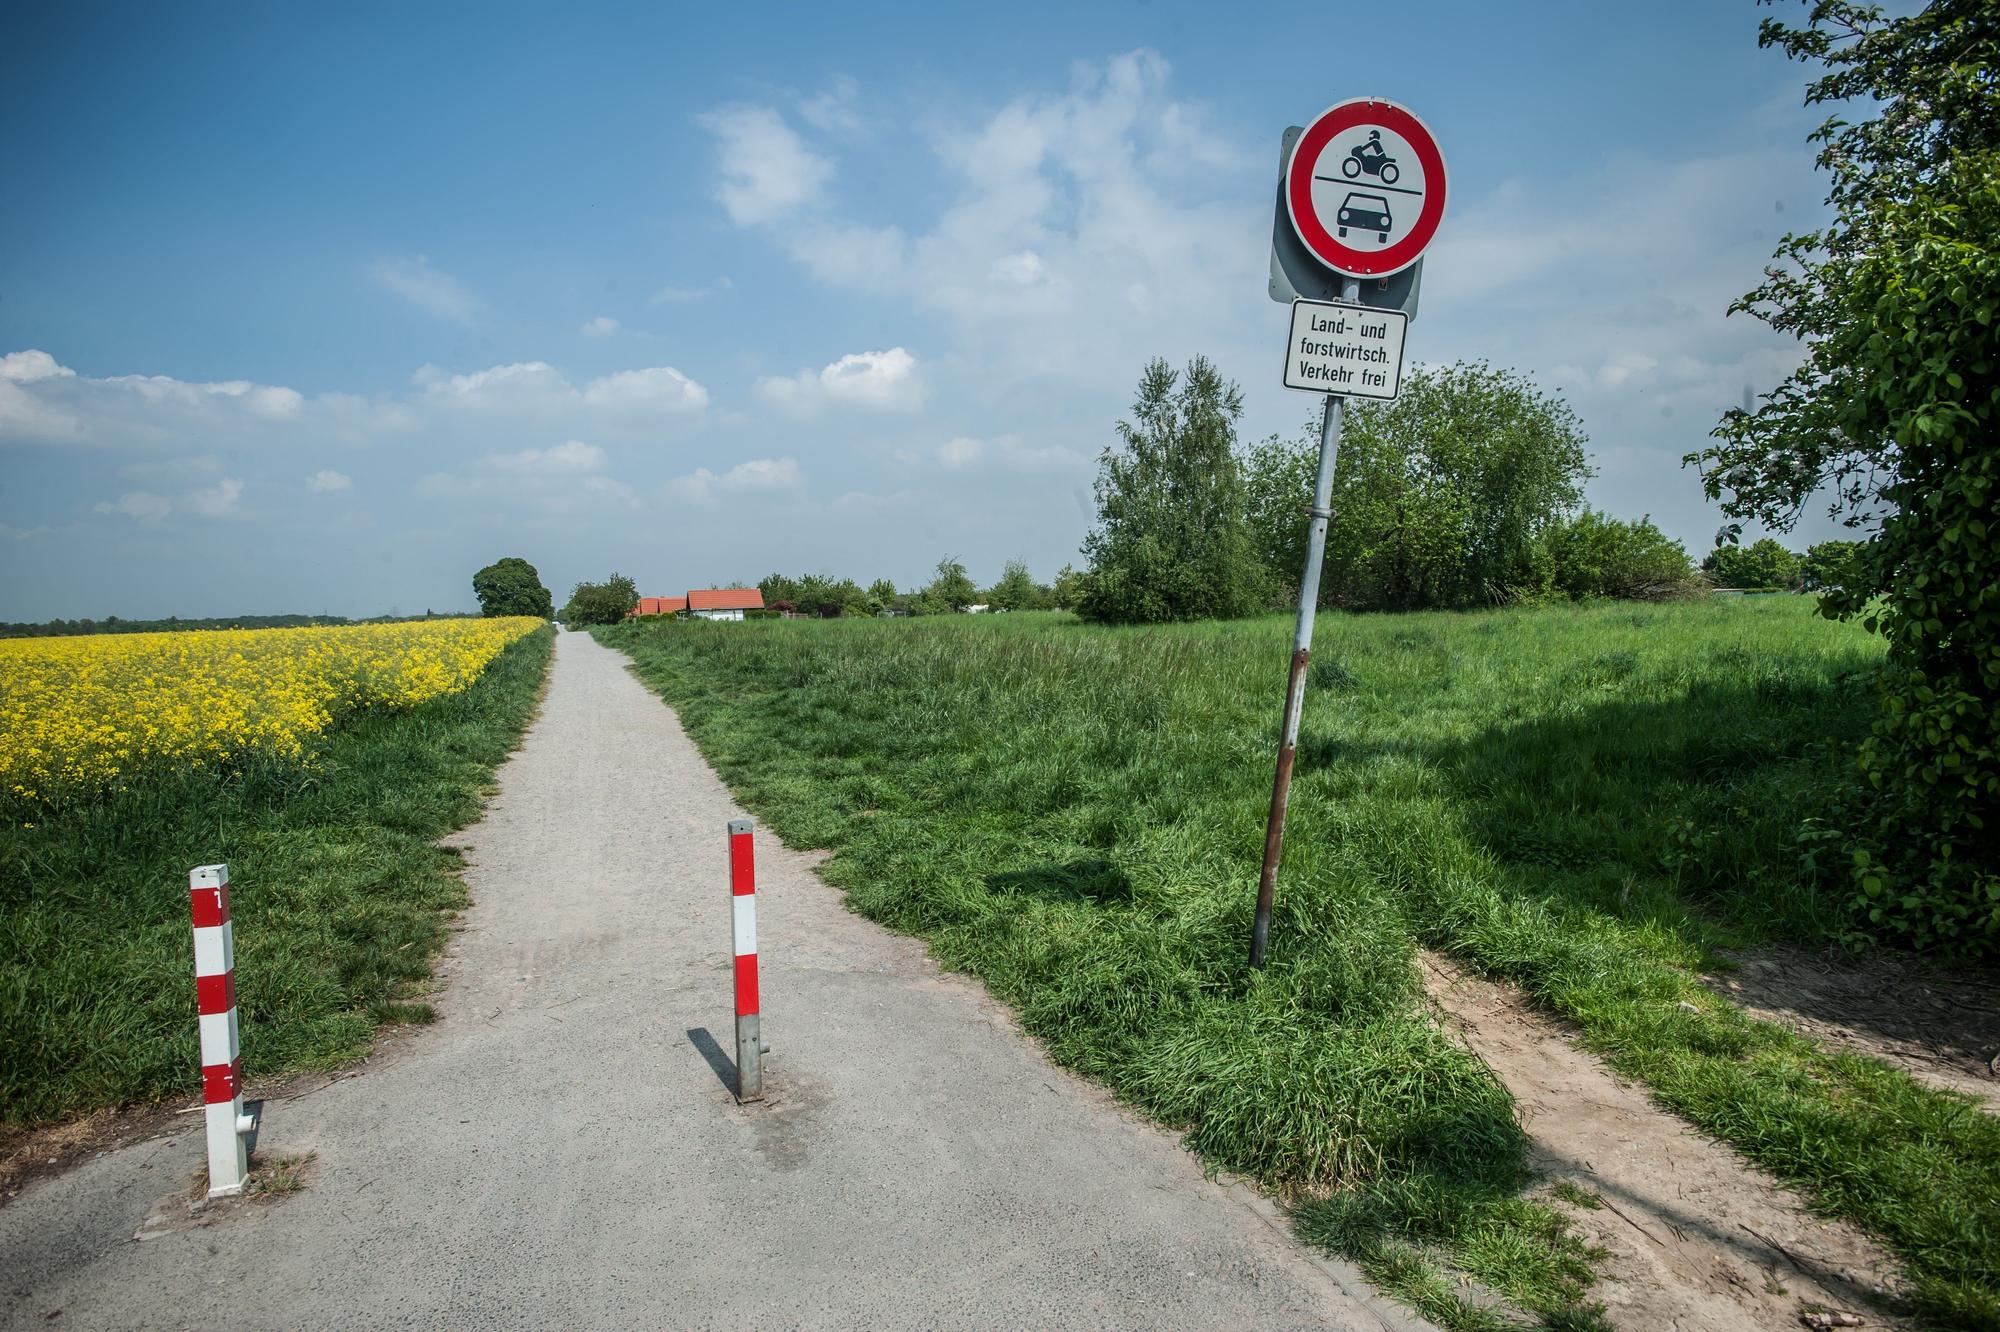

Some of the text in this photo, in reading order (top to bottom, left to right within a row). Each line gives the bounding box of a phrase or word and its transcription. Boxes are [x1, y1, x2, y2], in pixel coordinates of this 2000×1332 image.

[1311, 314, 1386, 339] Land- und
[1300, 337, 1390, 364] forstwirtsch.
[1300, 360, 1386, 387] Verkehr frei
